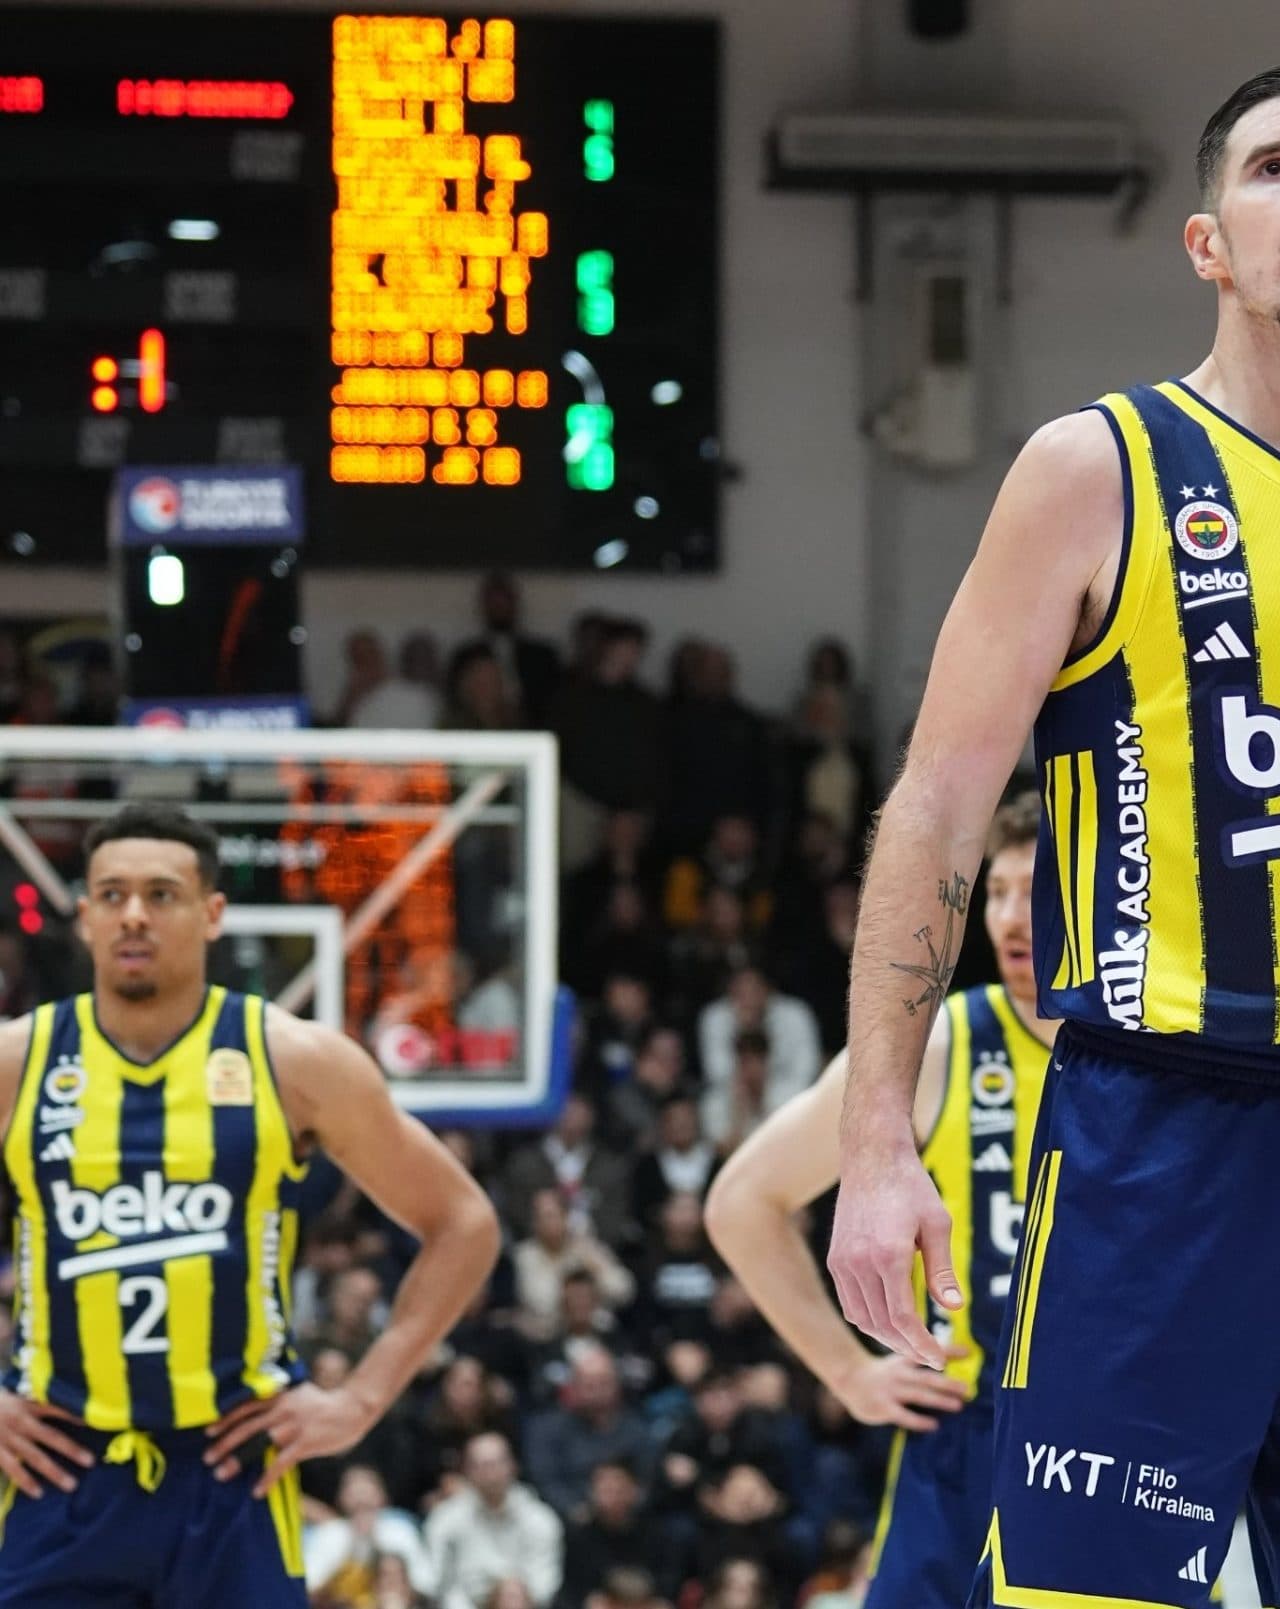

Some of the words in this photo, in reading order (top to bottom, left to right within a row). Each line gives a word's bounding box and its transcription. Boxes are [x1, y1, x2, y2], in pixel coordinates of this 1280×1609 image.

[1179, 568, 1248, 594] beko
[1113, 719, 1149, 922] ACADEMY
[51, 1170, 234, 1241] beko
[117, 1275, 171, 1355] 2
[1024, 1441, 1115, 1497] YKT
[1138, 1464, 1178, 1490] Filo
[1134, 1486, 1216, 1522] Kiralama
